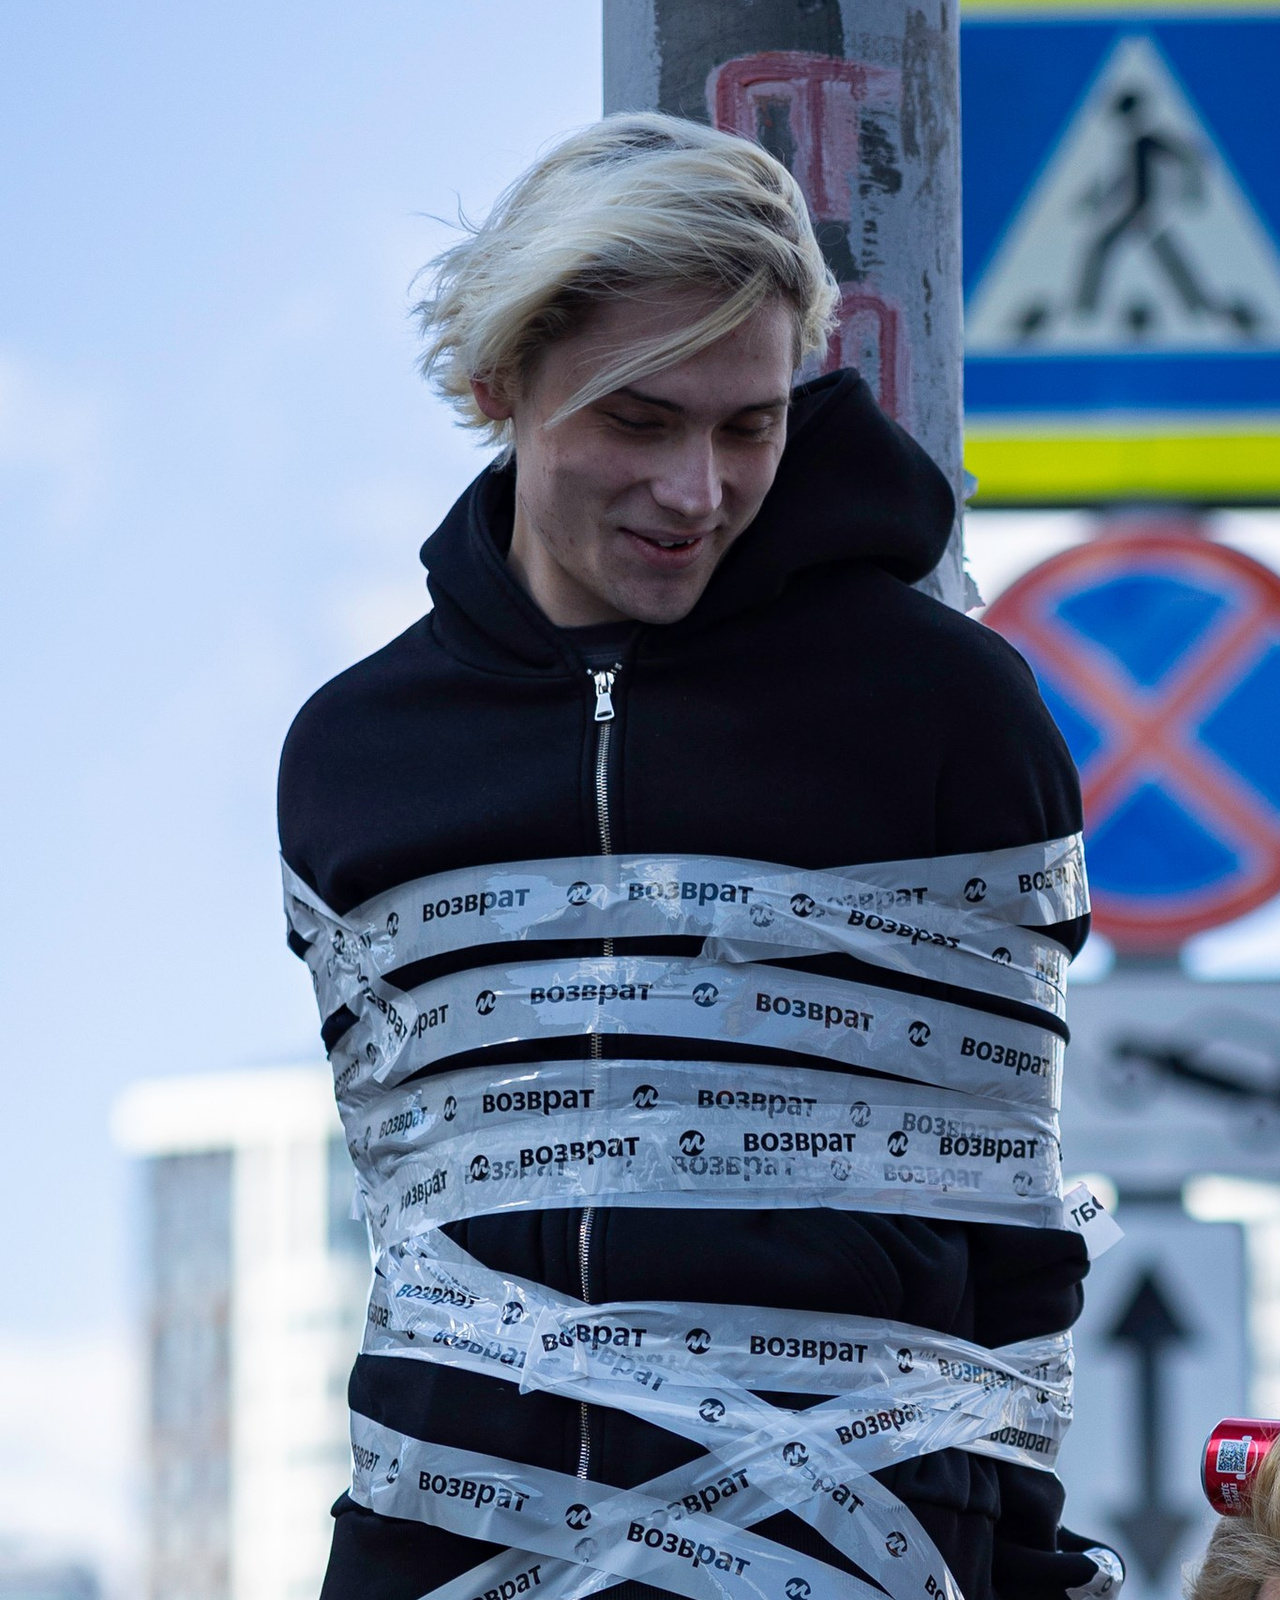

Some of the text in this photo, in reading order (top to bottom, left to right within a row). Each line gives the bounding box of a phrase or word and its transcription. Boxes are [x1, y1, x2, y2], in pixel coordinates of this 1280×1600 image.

[422, 880, 960, 949] возврат возврат возврат
[530, 983, 654, 1006] возврат
[755, 992, 875, 1032] возврат
[960, 1036, 1051, 1079] возврат
[379, 1106, 428, 1139] возврат
[482, 1088, 595, 1115] возврат
[697, 1088, 818, 1119] возврат
[520, 1136, 641, 1168] возврат
[743, 1132, 856, 1157] возврат
[939, 1136, 1039, 1164] возврат
[396, 1284, 480, 1309] возврат
[750, 1334, 869, 1366] возврат
[1220, 1482, 1233, 1508] ЗДЕСЬ
[418, 1470, 530, 1513] возврат
[626, 1521, 751, 1577] возврат
